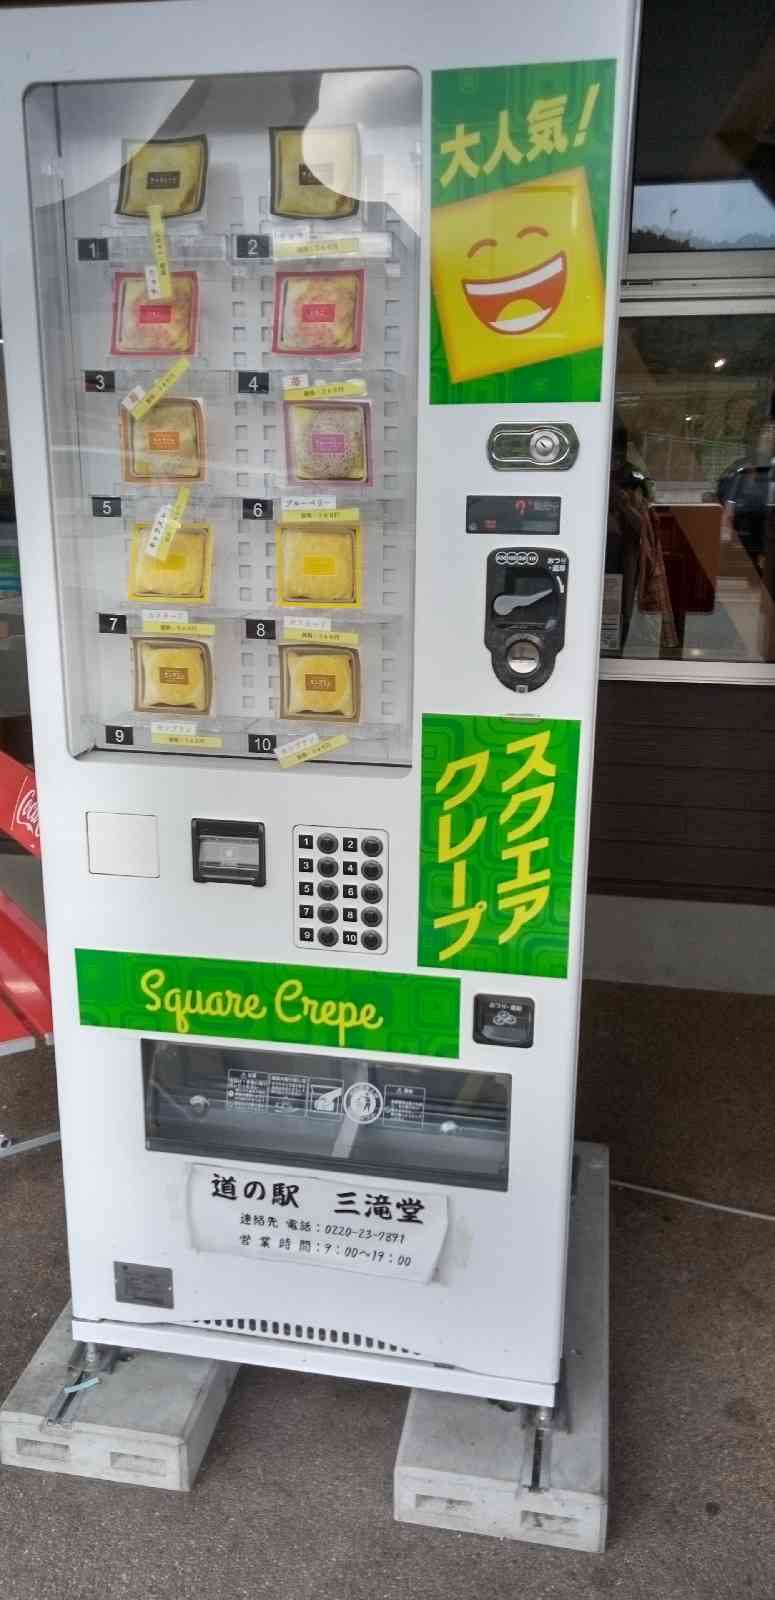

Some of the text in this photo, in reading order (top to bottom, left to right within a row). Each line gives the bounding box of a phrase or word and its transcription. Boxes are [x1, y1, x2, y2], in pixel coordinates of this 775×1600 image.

[248, 239, 259, 256] 2
[95, 374, 105, 390] 3
[248, 375, 259, 391] 4
[102, 500, 112, 515] 5
[253, 502, 263, 518] 6
[109, 617, 118, 631] 7
[256, 623, 265, 637] 8
[114, 729, 124, 743] 9
[255, 737, 271, 751] 10
[496, 729, 557, 946] スクエア
[347, 840, 354, 850] 2
[433, 749, 490, 962] クレープ
[303, 861, 309, 870] 3
[347, 864, 353, 873] 4
[304, 884, 310, 893] 5
[347, 887, 354, 896] 6
[303, 907, 310, 916] 7
[347, 911, 353, 919] 8
[304, 931, 310, 939] 9
[345, 934, 356, 943] 10
[140, 968, 384, 1047] Square Crepe
[211, 1173, 425, 1225] 道の駅 三滝堂
[239, 1213, 279, 1229] 連絡先
